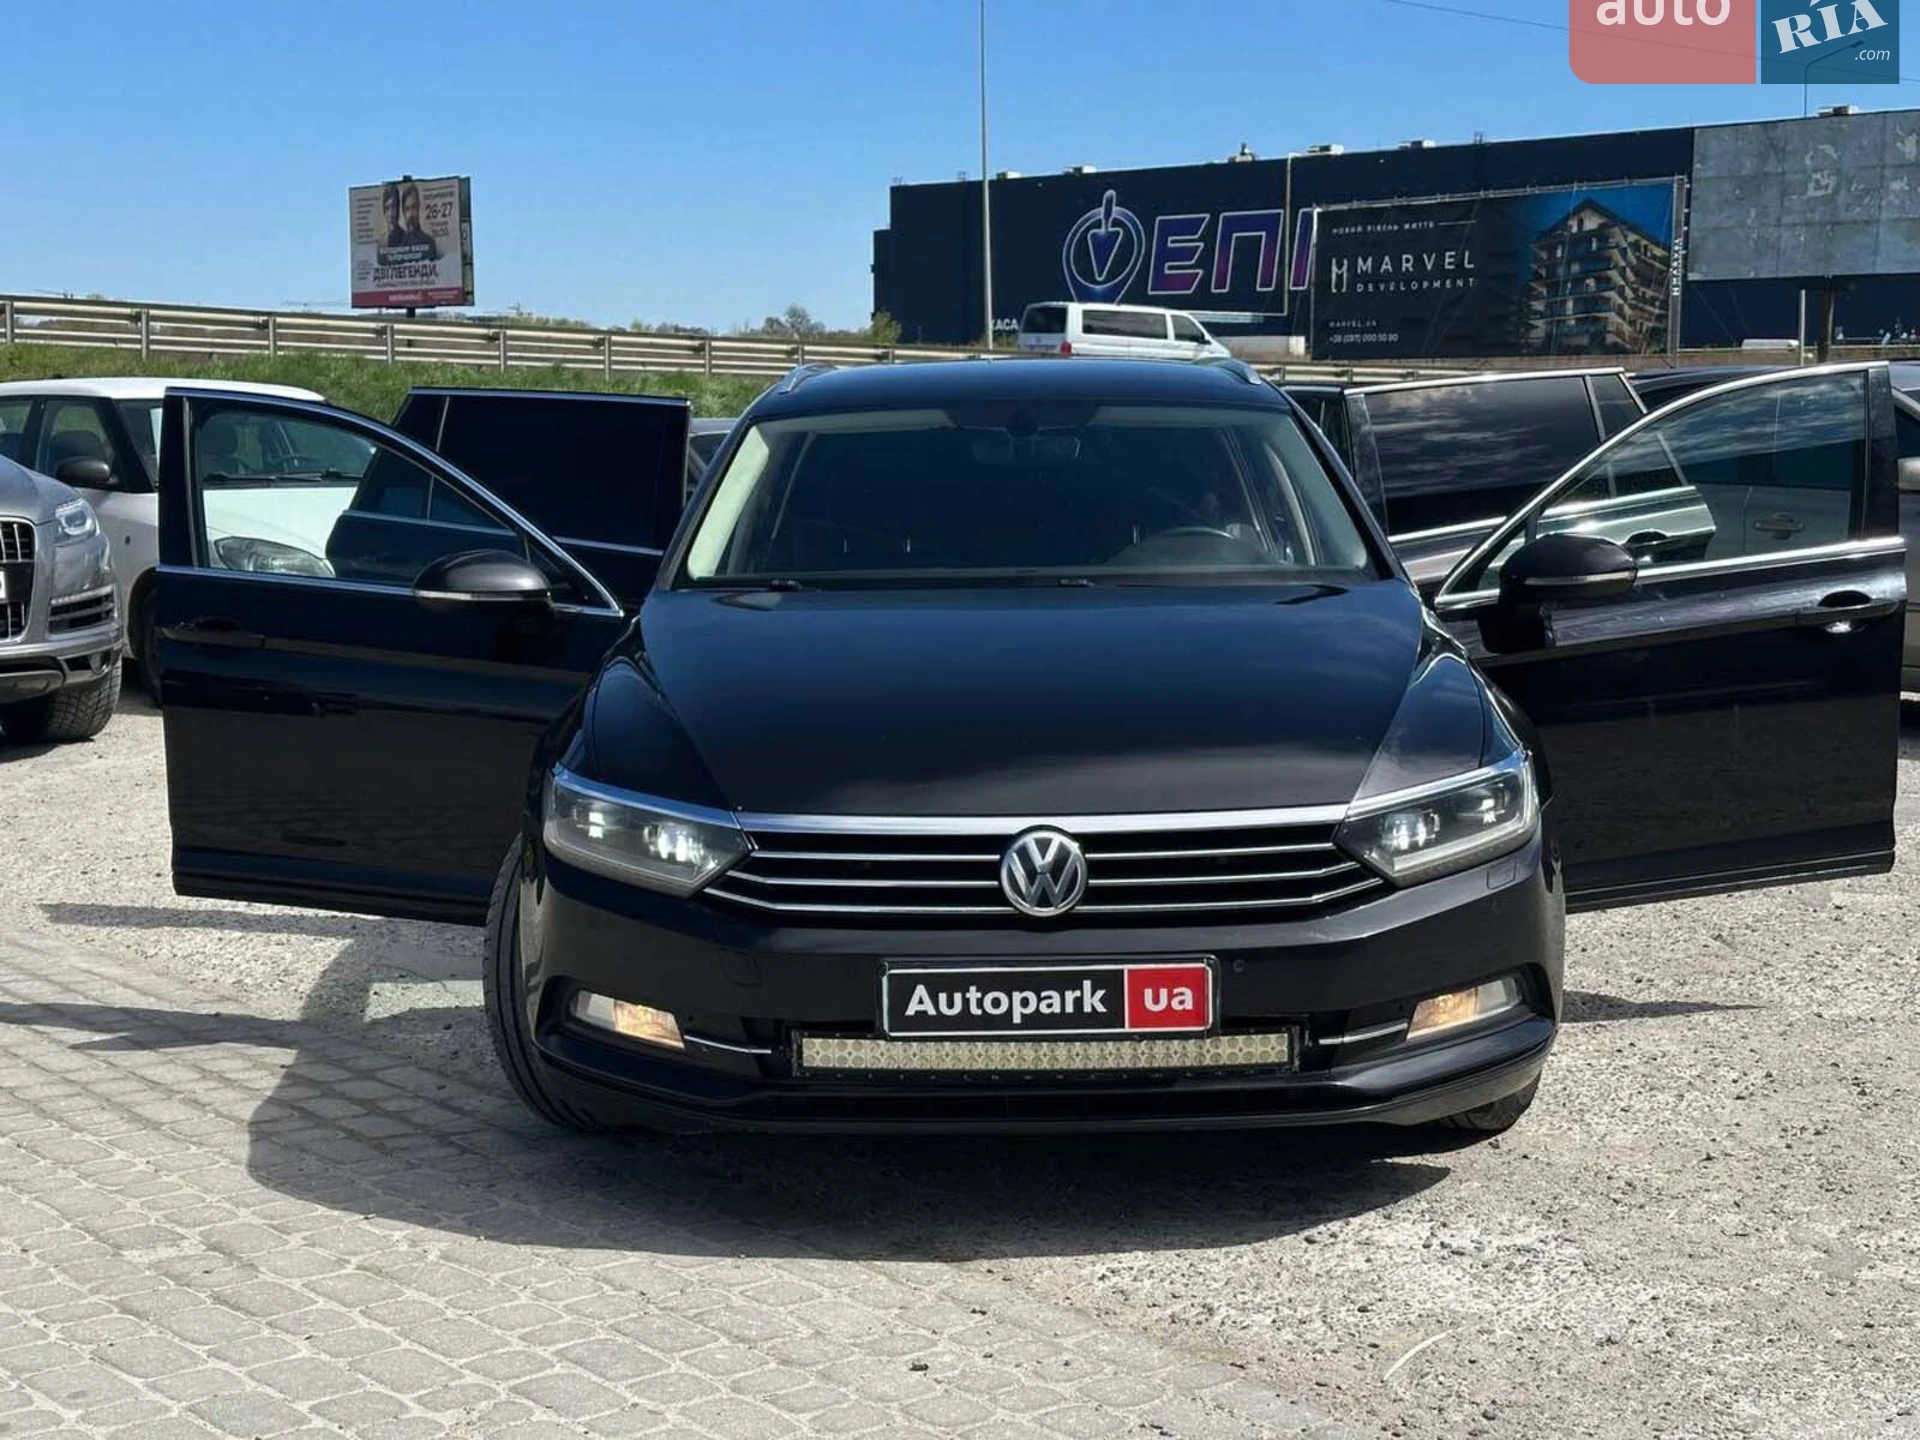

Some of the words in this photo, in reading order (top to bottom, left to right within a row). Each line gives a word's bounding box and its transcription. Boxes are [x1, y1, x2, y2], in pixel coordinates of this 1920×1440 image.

[1357, 250, 1475, 275] MARVEL
[1356, 277, 1475, 293] DEVELOPMENT
[905, 980, 1107, 1023] Autopark
[1144, 986, 1193, 1012] ua
